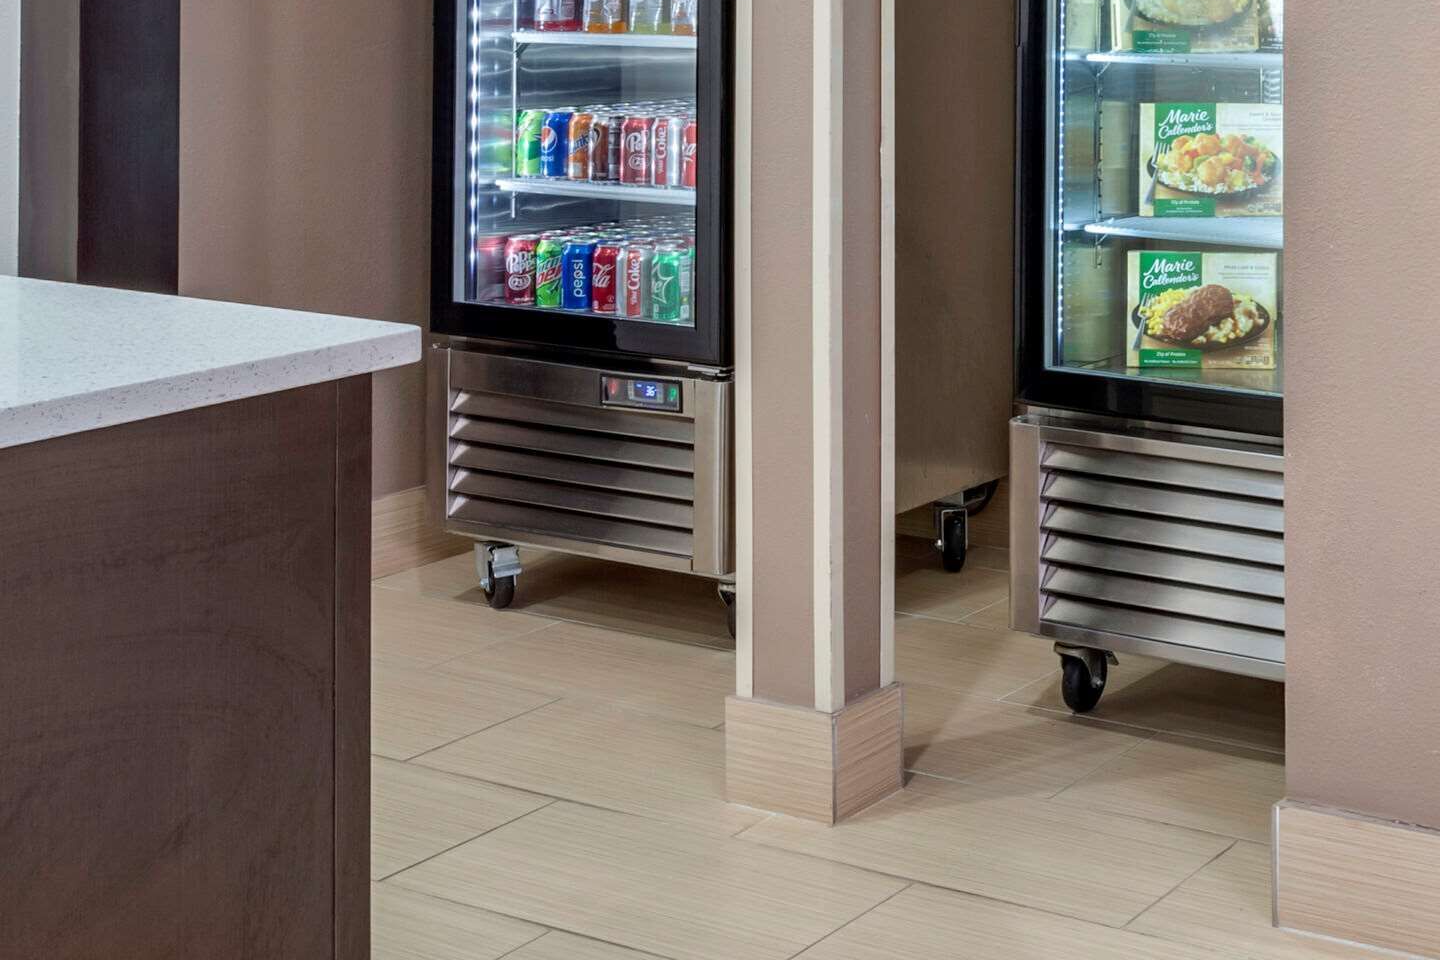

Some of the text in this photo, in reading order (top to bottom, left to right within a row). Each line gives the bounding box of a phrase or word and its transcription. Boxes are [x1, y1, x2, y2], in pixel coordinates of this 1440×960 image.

[1158, 109, 1210, 127] Marie
[1158, 124, 1214, 139] Callender's
[628, 258, 640, 290] Coke
[1143, 259, 1195, 276] Marie
[571, 260, 586, 297] pepsi
[1143, 273, 1200, 289] Callender's
